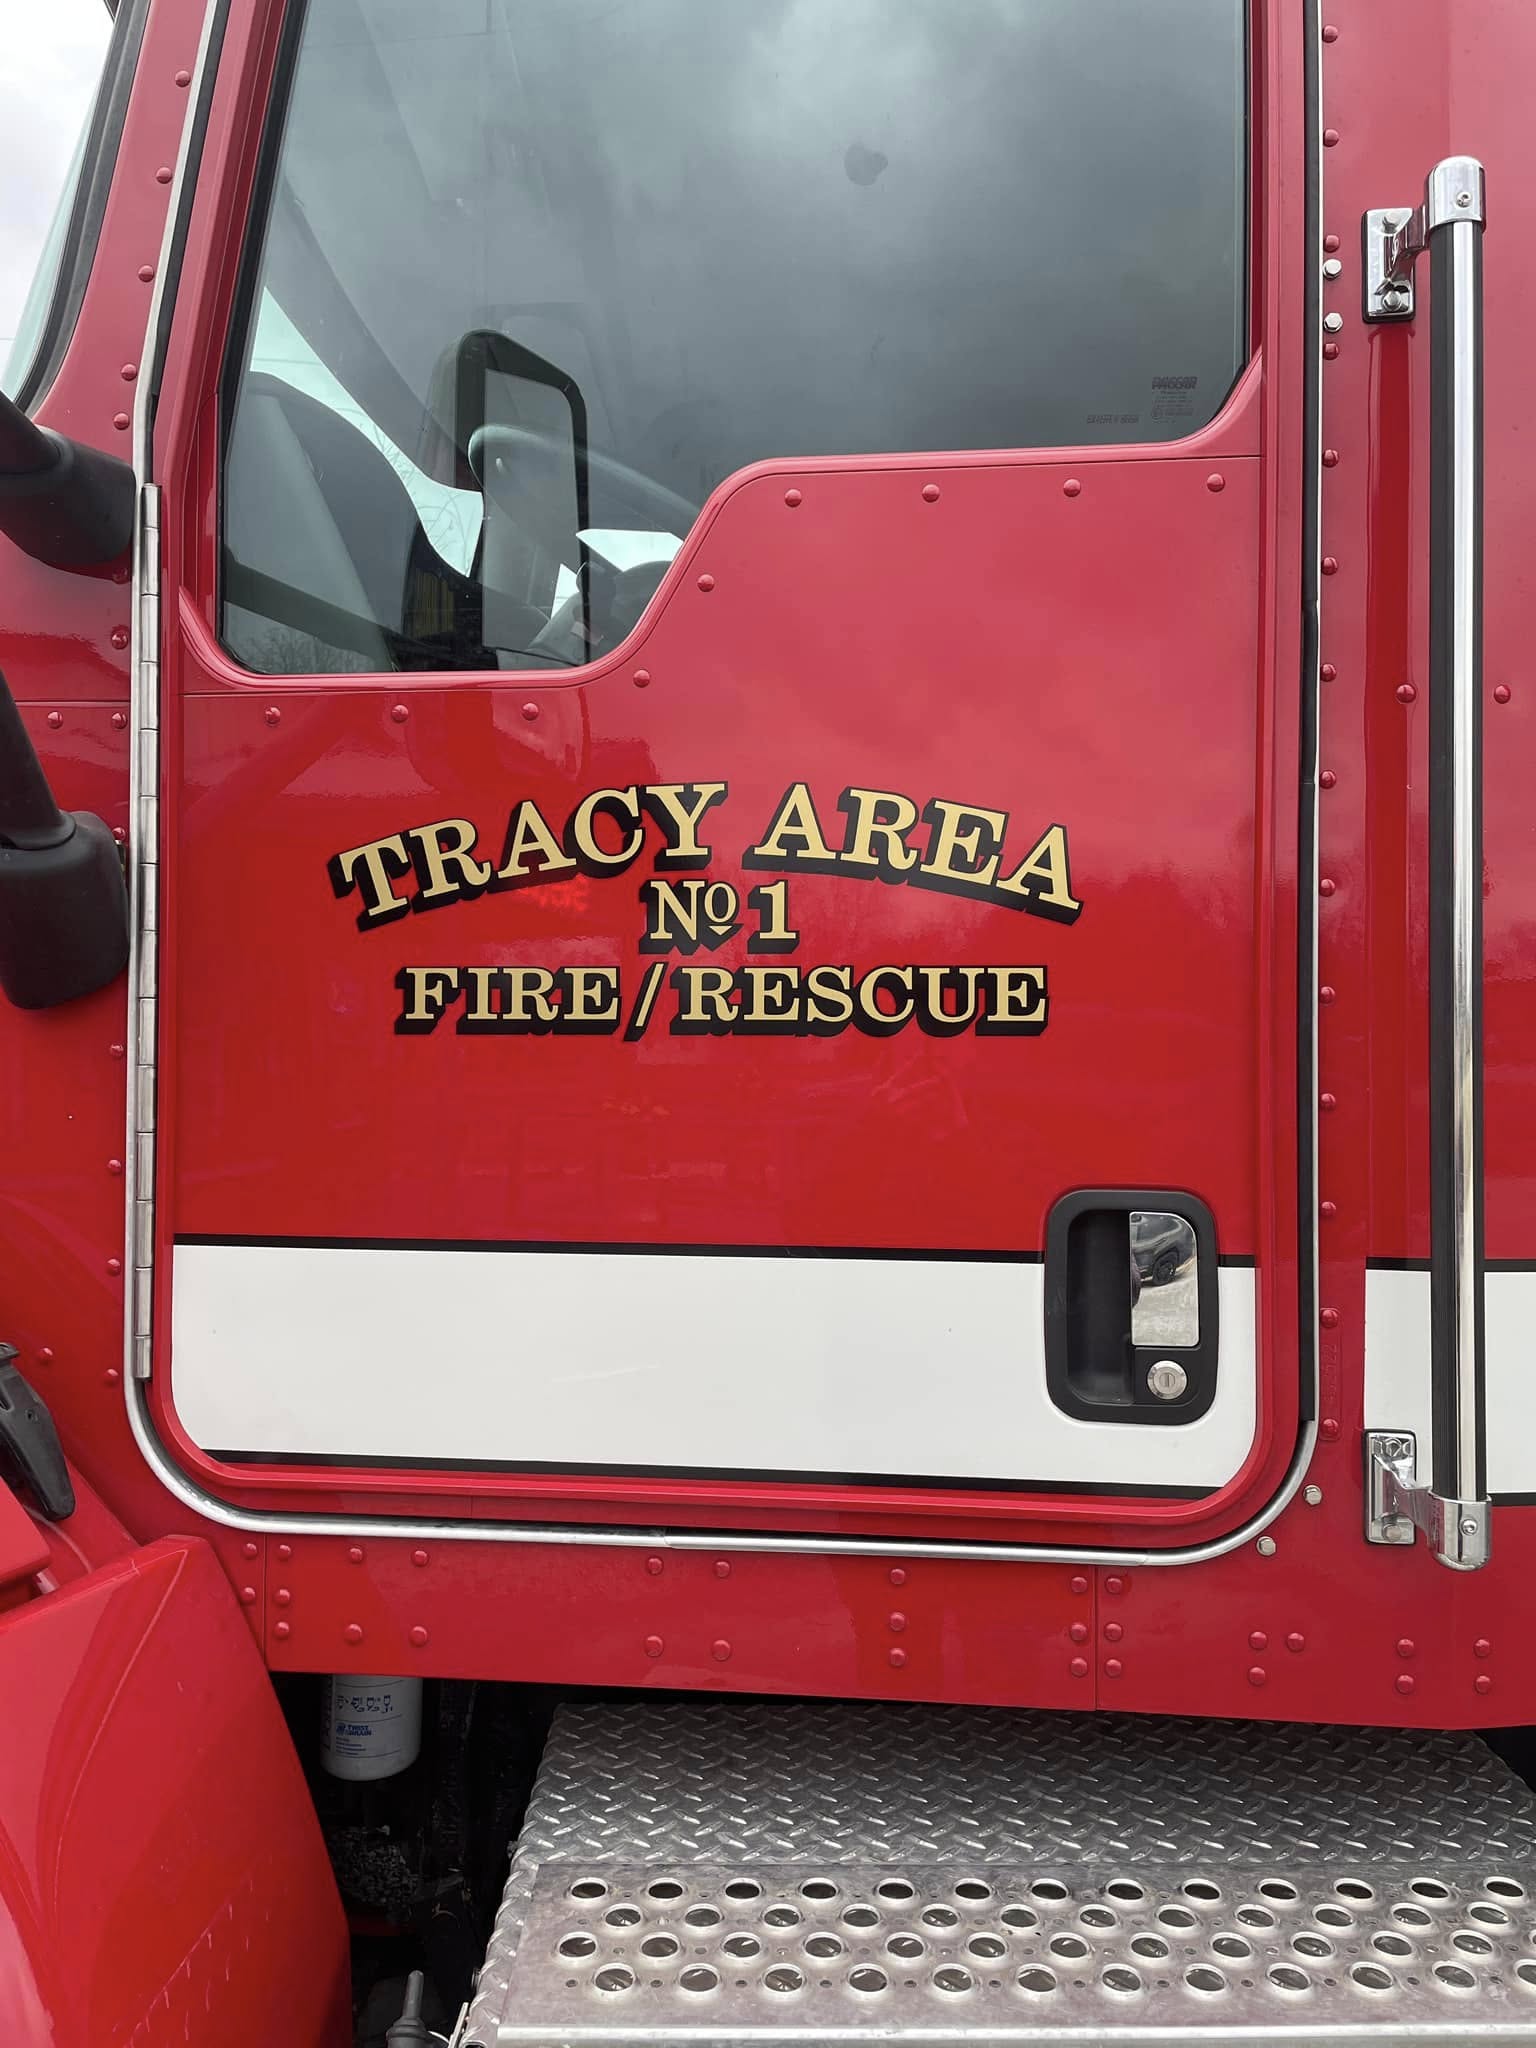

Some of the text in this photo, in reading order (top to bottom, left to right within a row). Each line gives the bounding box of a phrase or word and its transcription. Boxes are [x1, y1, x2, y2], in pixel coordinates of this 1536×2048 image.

[339, 782, 1081, 917] TRACY AREA
[760, 882, 795, 938] 1
